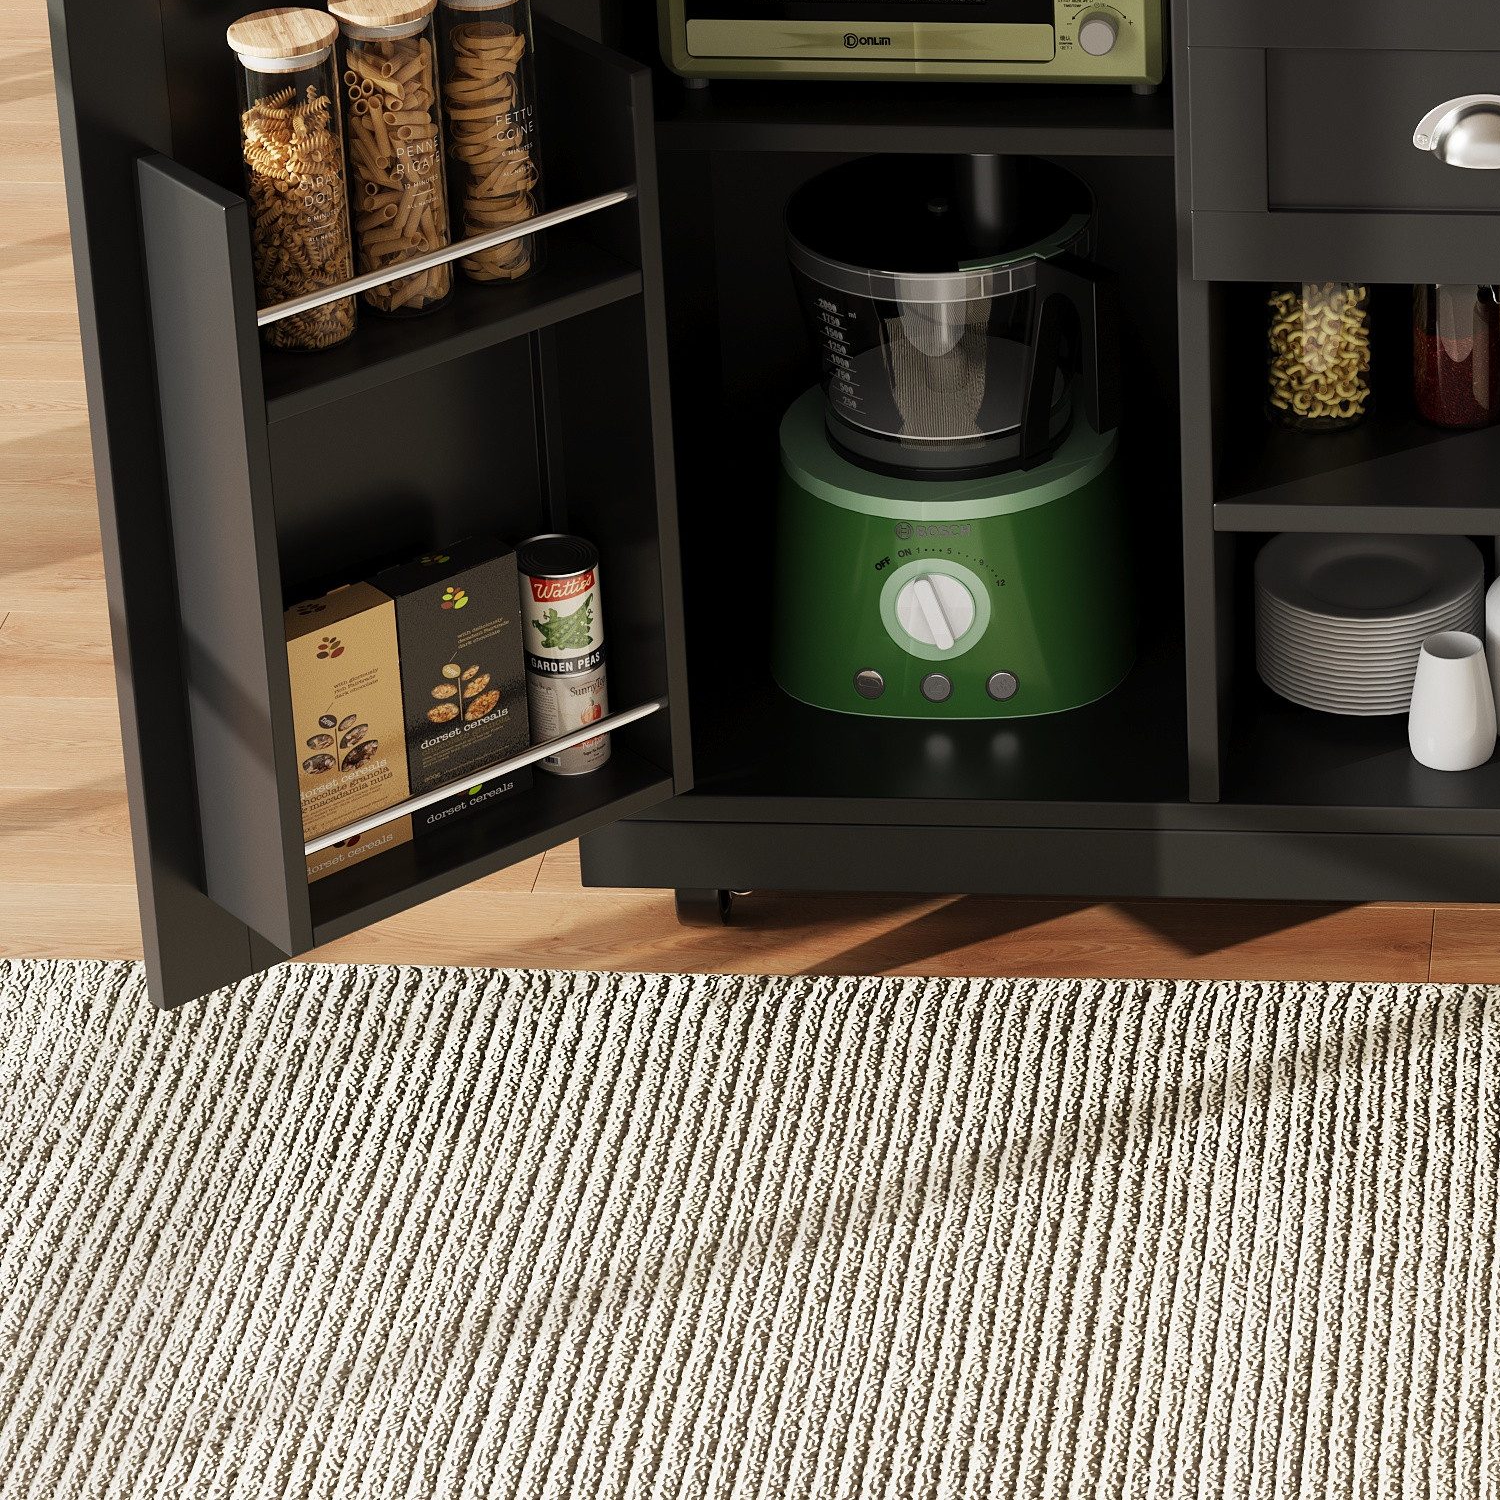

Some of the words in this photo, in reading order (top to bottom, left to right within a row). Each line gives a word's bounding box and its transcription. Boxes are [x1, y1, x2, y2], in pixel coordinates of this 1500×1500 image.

[495, 104, 533, 127] FETTU
[496, 120, 534, 142] CCINE
[396, 135, 438, 159] PENNE
[304, 186, 340, 207] DOLE
[915, 524, 972, 536] BOSCH
[874, 556, 891, 571] OFF
[897, 548, 912, 558] ON
[996, 578, 1006, 587] 12
[531, 657, 573, 672] GARDEN
[577, 651, 600, 670] PEAS
[420, 727, 461, 750] dorset
[463, 707, 509, 731] cereals
[341, 759, 387, 783] cereals
[349, 766, 390, 789] granola
[310, 782, 369, 811] macadamia
[370, 771, 394, 785] nuts
[426, 801, 467, 824] dorset
[469, 781, 514, 806] cereals
[347, 833, 394, 858] cereals
